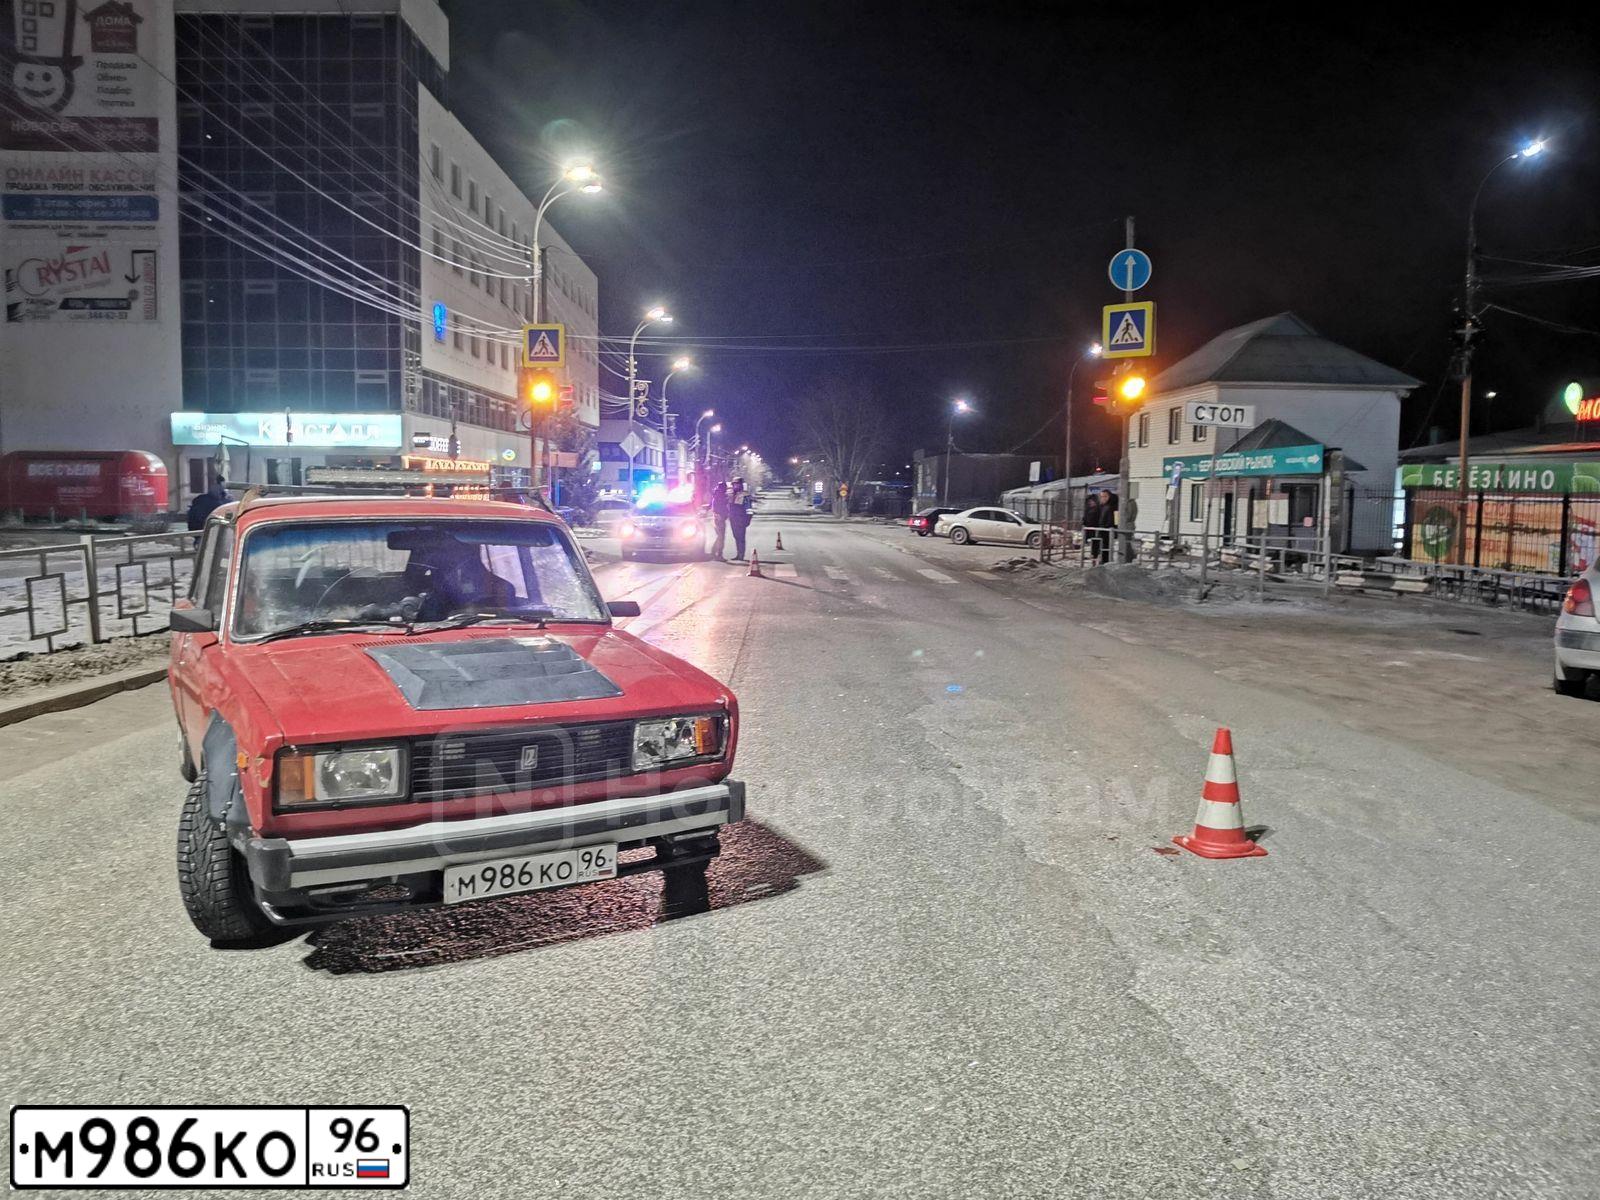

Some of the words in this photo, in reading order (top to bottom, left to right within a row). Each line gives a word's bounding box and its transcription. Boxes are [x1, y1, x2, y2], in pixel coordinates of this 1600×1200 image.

[1194, 405, 1245, 423] СТОП
[1433, 466, 1555, 490] БЕЁЗКИНО
[581, 849, 606, 870] 96
